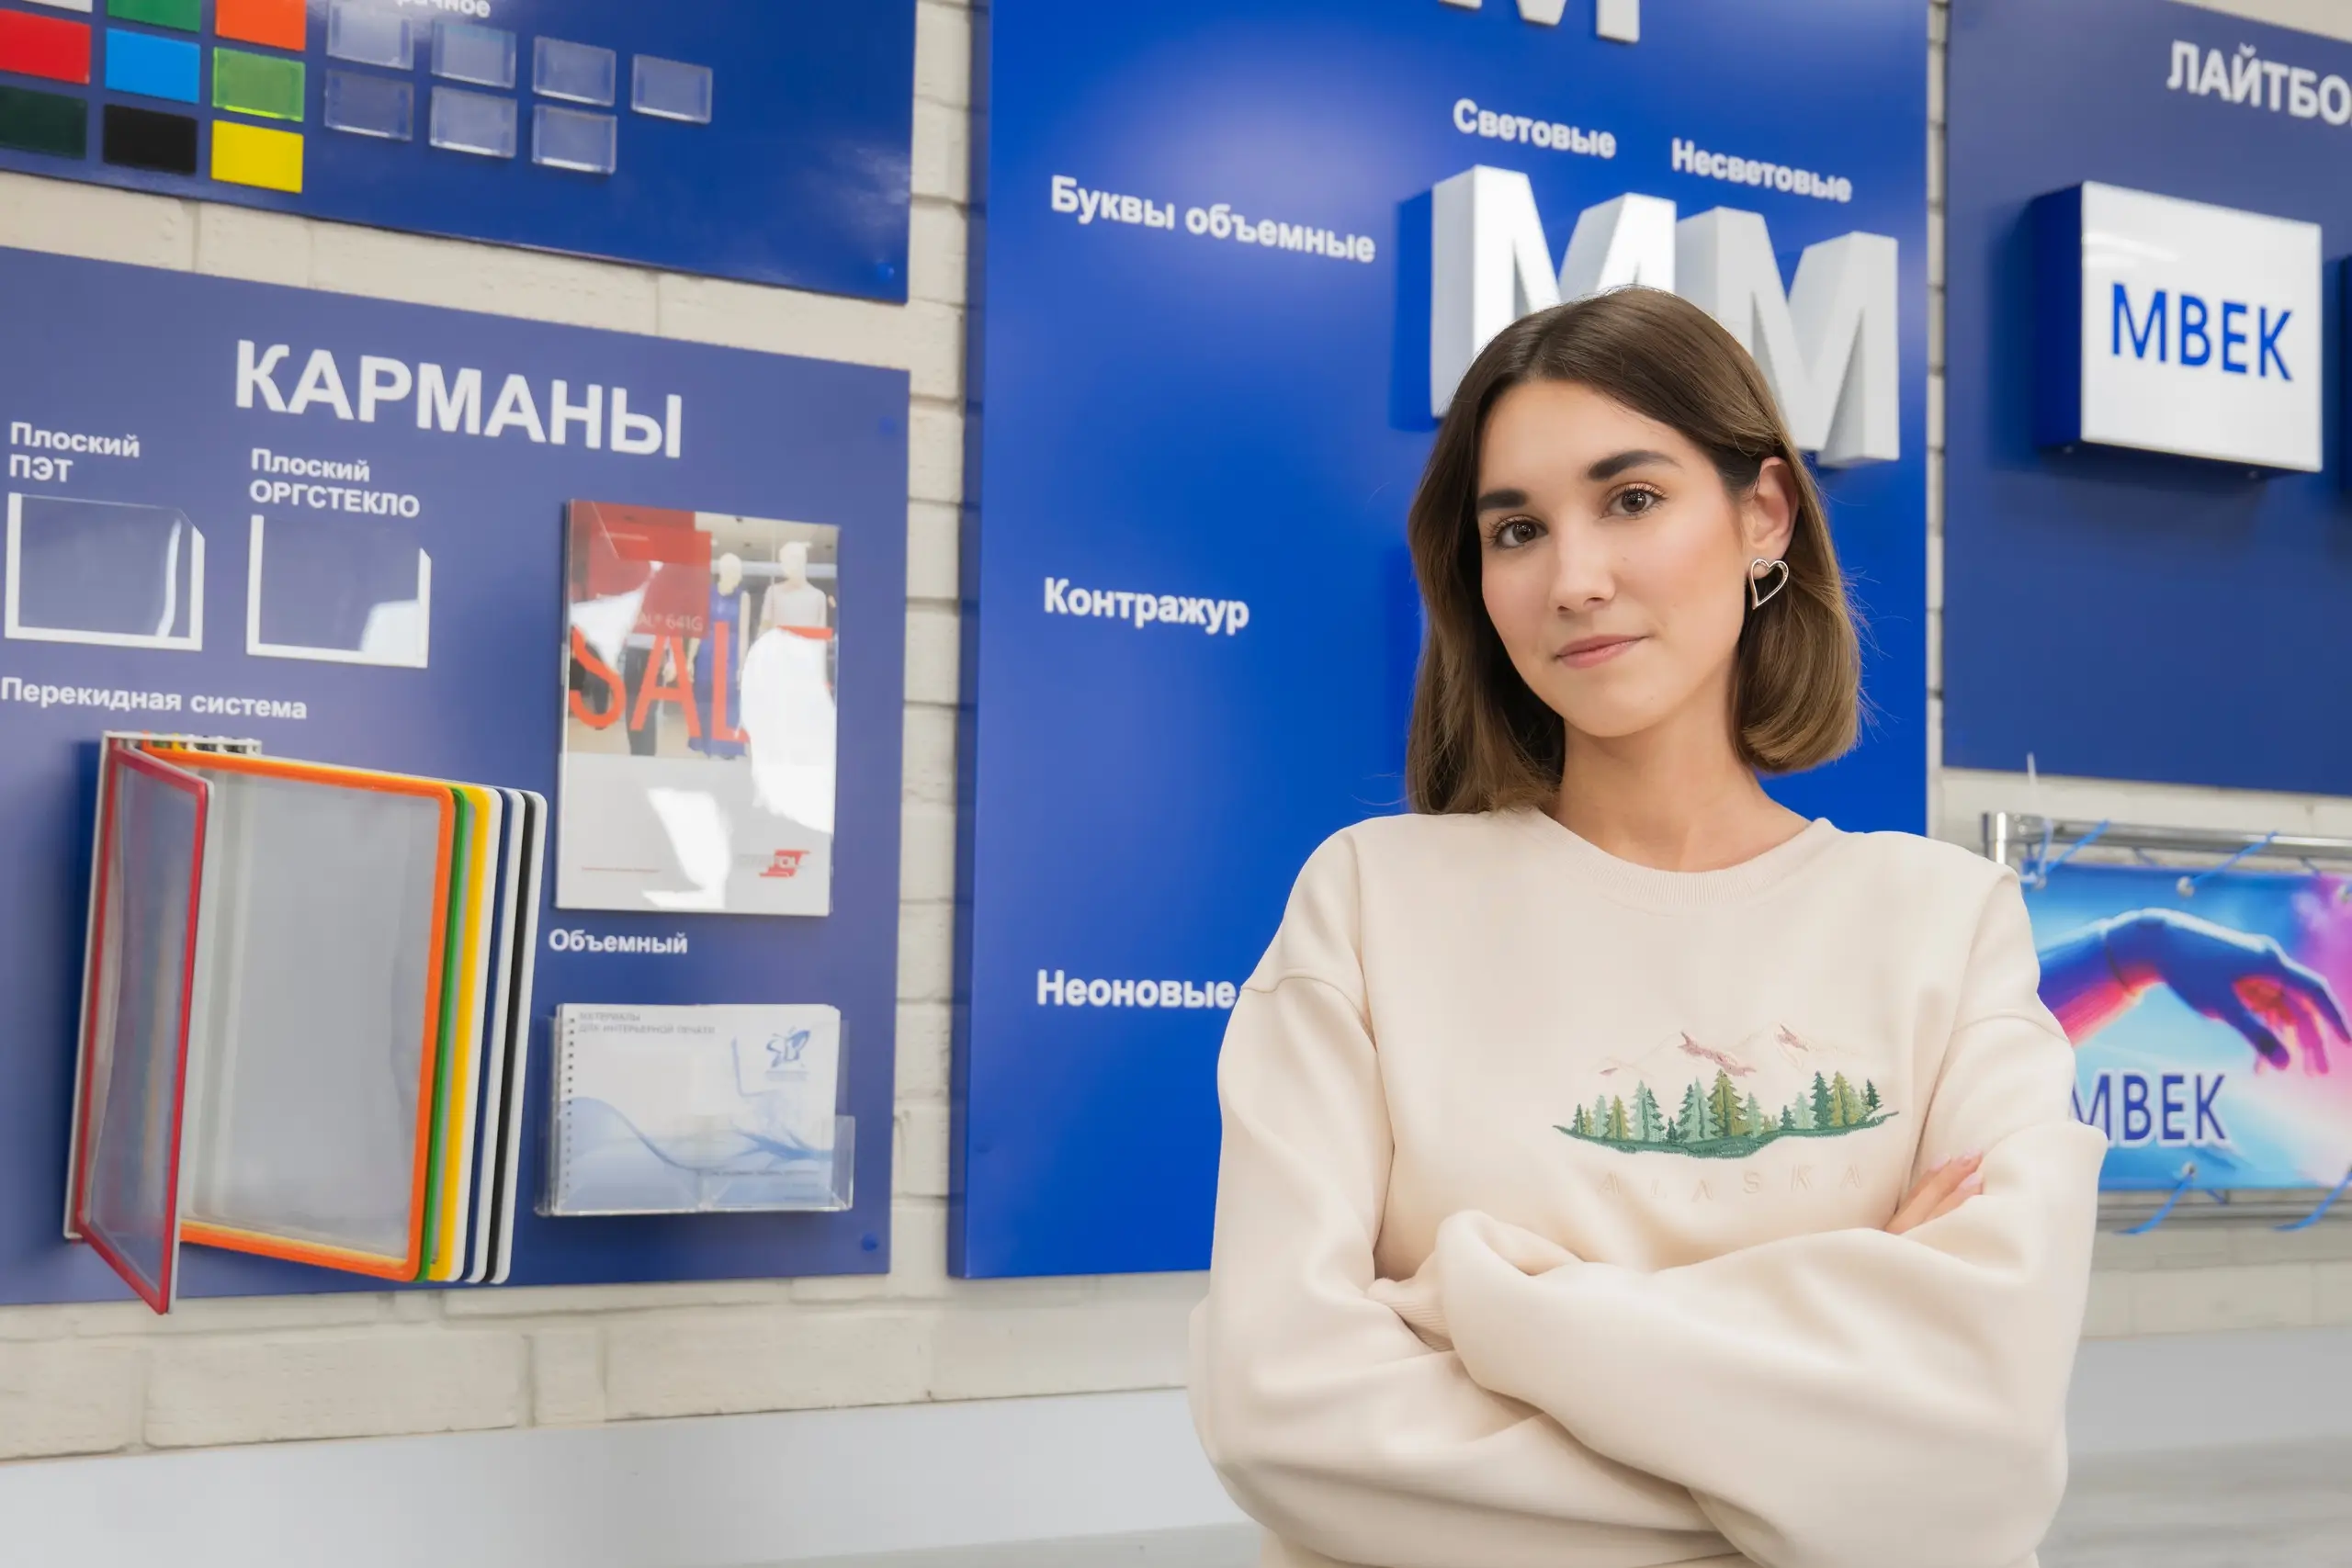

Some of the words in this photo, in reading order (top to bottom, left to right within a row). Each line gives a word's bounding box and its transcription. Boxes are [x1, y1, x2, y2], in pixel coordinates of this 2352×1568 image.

[2166, 39, 2352, 126] ЛАЙТБО
[1453, 97, 1617, 160] Световые
[1671, 138, 1853, 204] Несветовые
[1050, 175, 1176, 231] Буквы
[1185, 202, 1376, 263] объемные
[2112, 282, 2293, 382] МВЕК
[235, 339, 683, 458] КАРМАНЫ
[10, 421, 141, 457] Плоский
[251, 447, 370, 481] Плоский
[9, 454, 74, 483] ПЭТ
[249, 479, 421, 518] ОРГСТЕКЛО
[1043, 576, 1250, 636] Контражур
[1, 676, 182, 711] Перекидная
[189, 694, 308, 719] система
[569, 621, 832, 743] SAL
[548, 928, 688, 954] Объемный
[1036, 969, 1237, 1010] Неоновые
[1599, 1163, 1862, 1201] ALASKA
